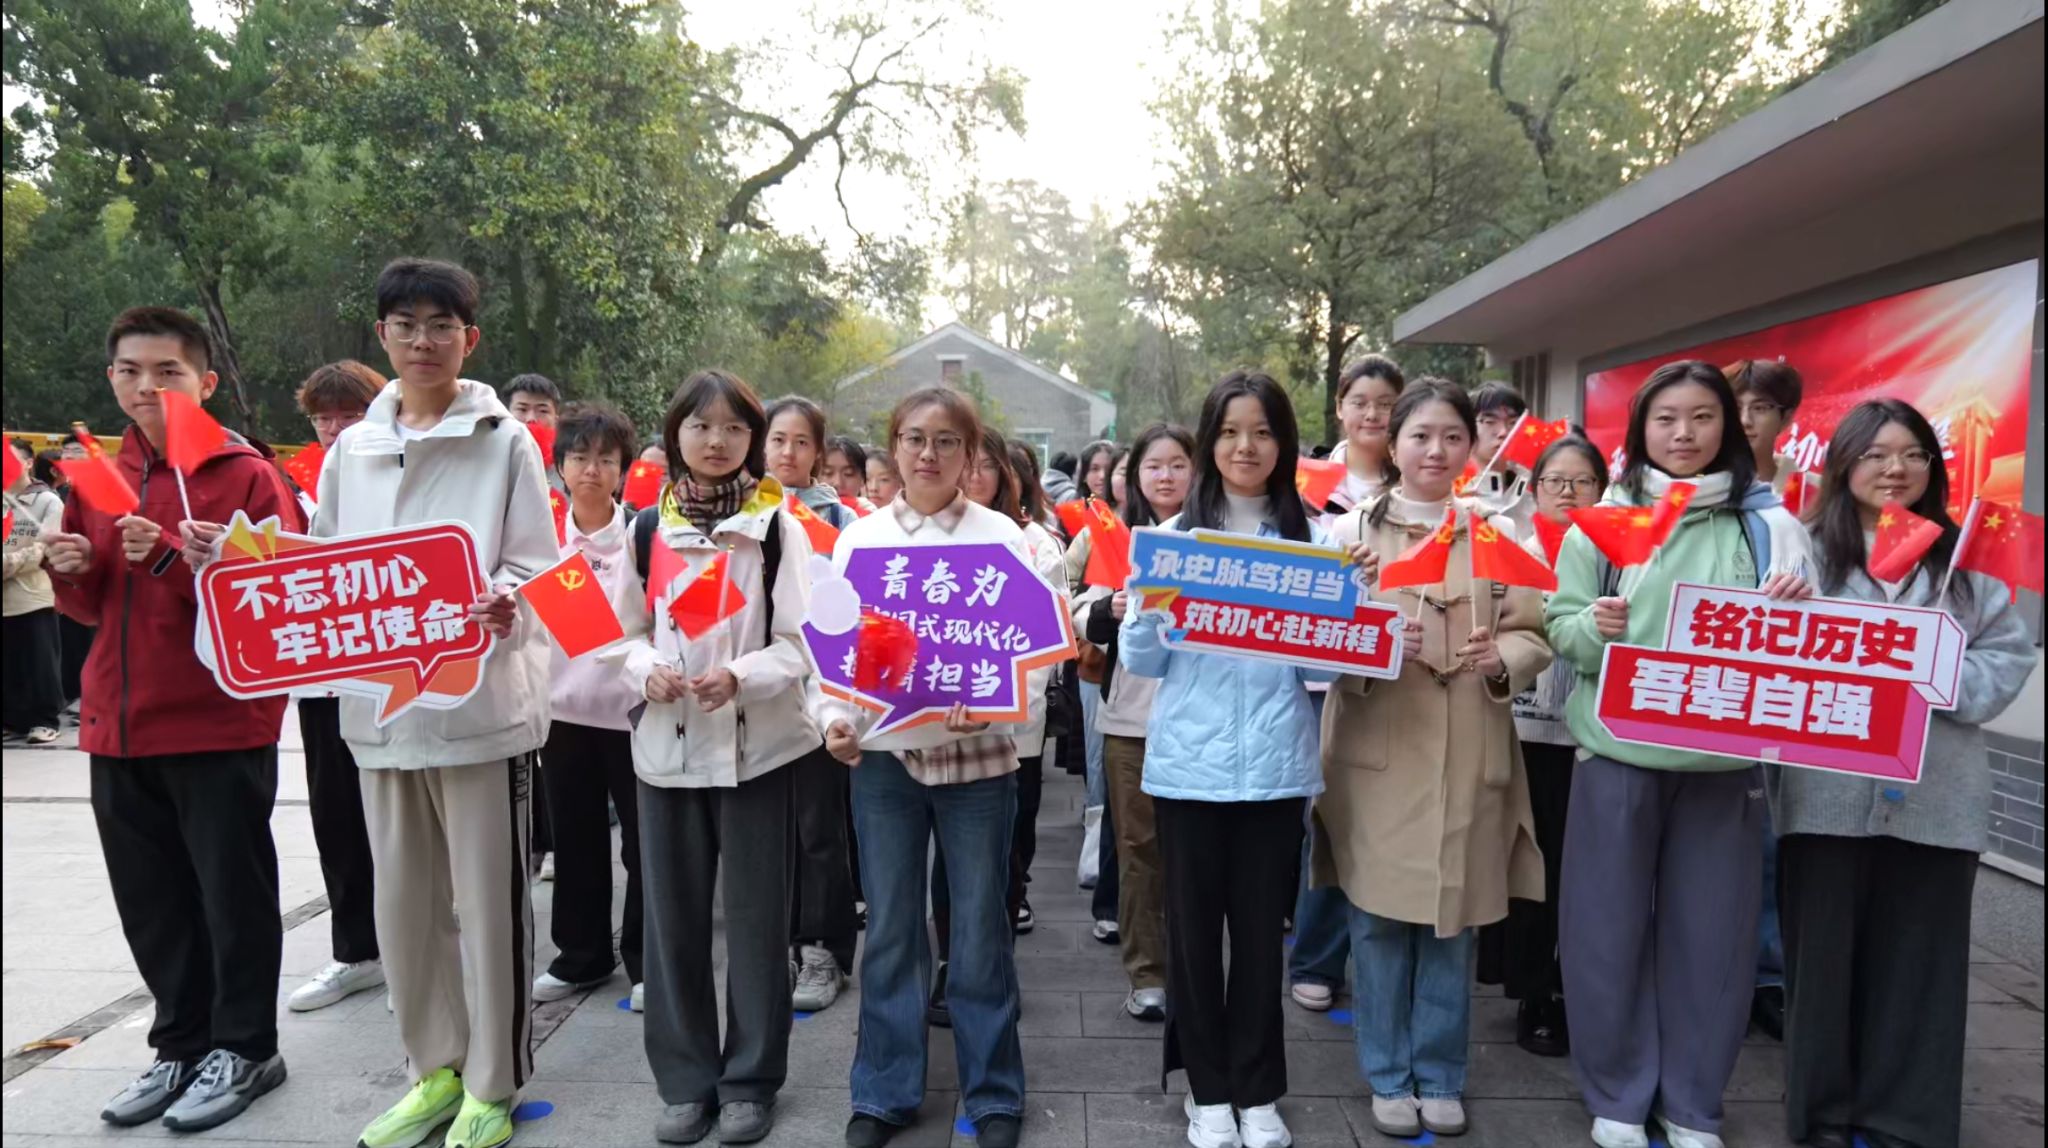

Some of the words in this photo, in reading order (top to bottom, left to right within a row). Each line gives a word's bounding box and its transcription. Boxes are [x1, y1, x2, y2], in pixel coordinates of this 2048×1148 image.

[231, 554, 428, 620] 不忘初心
[880, 553, 1008, 607] 青春为
[1148, 548, 1345, 602] 承史脉笃担当
[270, 599, 465, 665] 牢记使命
[873, 605, 1031, 652] 式现代化
[1183, 601, 1380, 655] 筑初心赴新程
[1689, 598, 1918, 671] 铭记历史
[839, 646, 1002, 698] 担当
[1629, 658, 1873, 740] 吾辈自强
